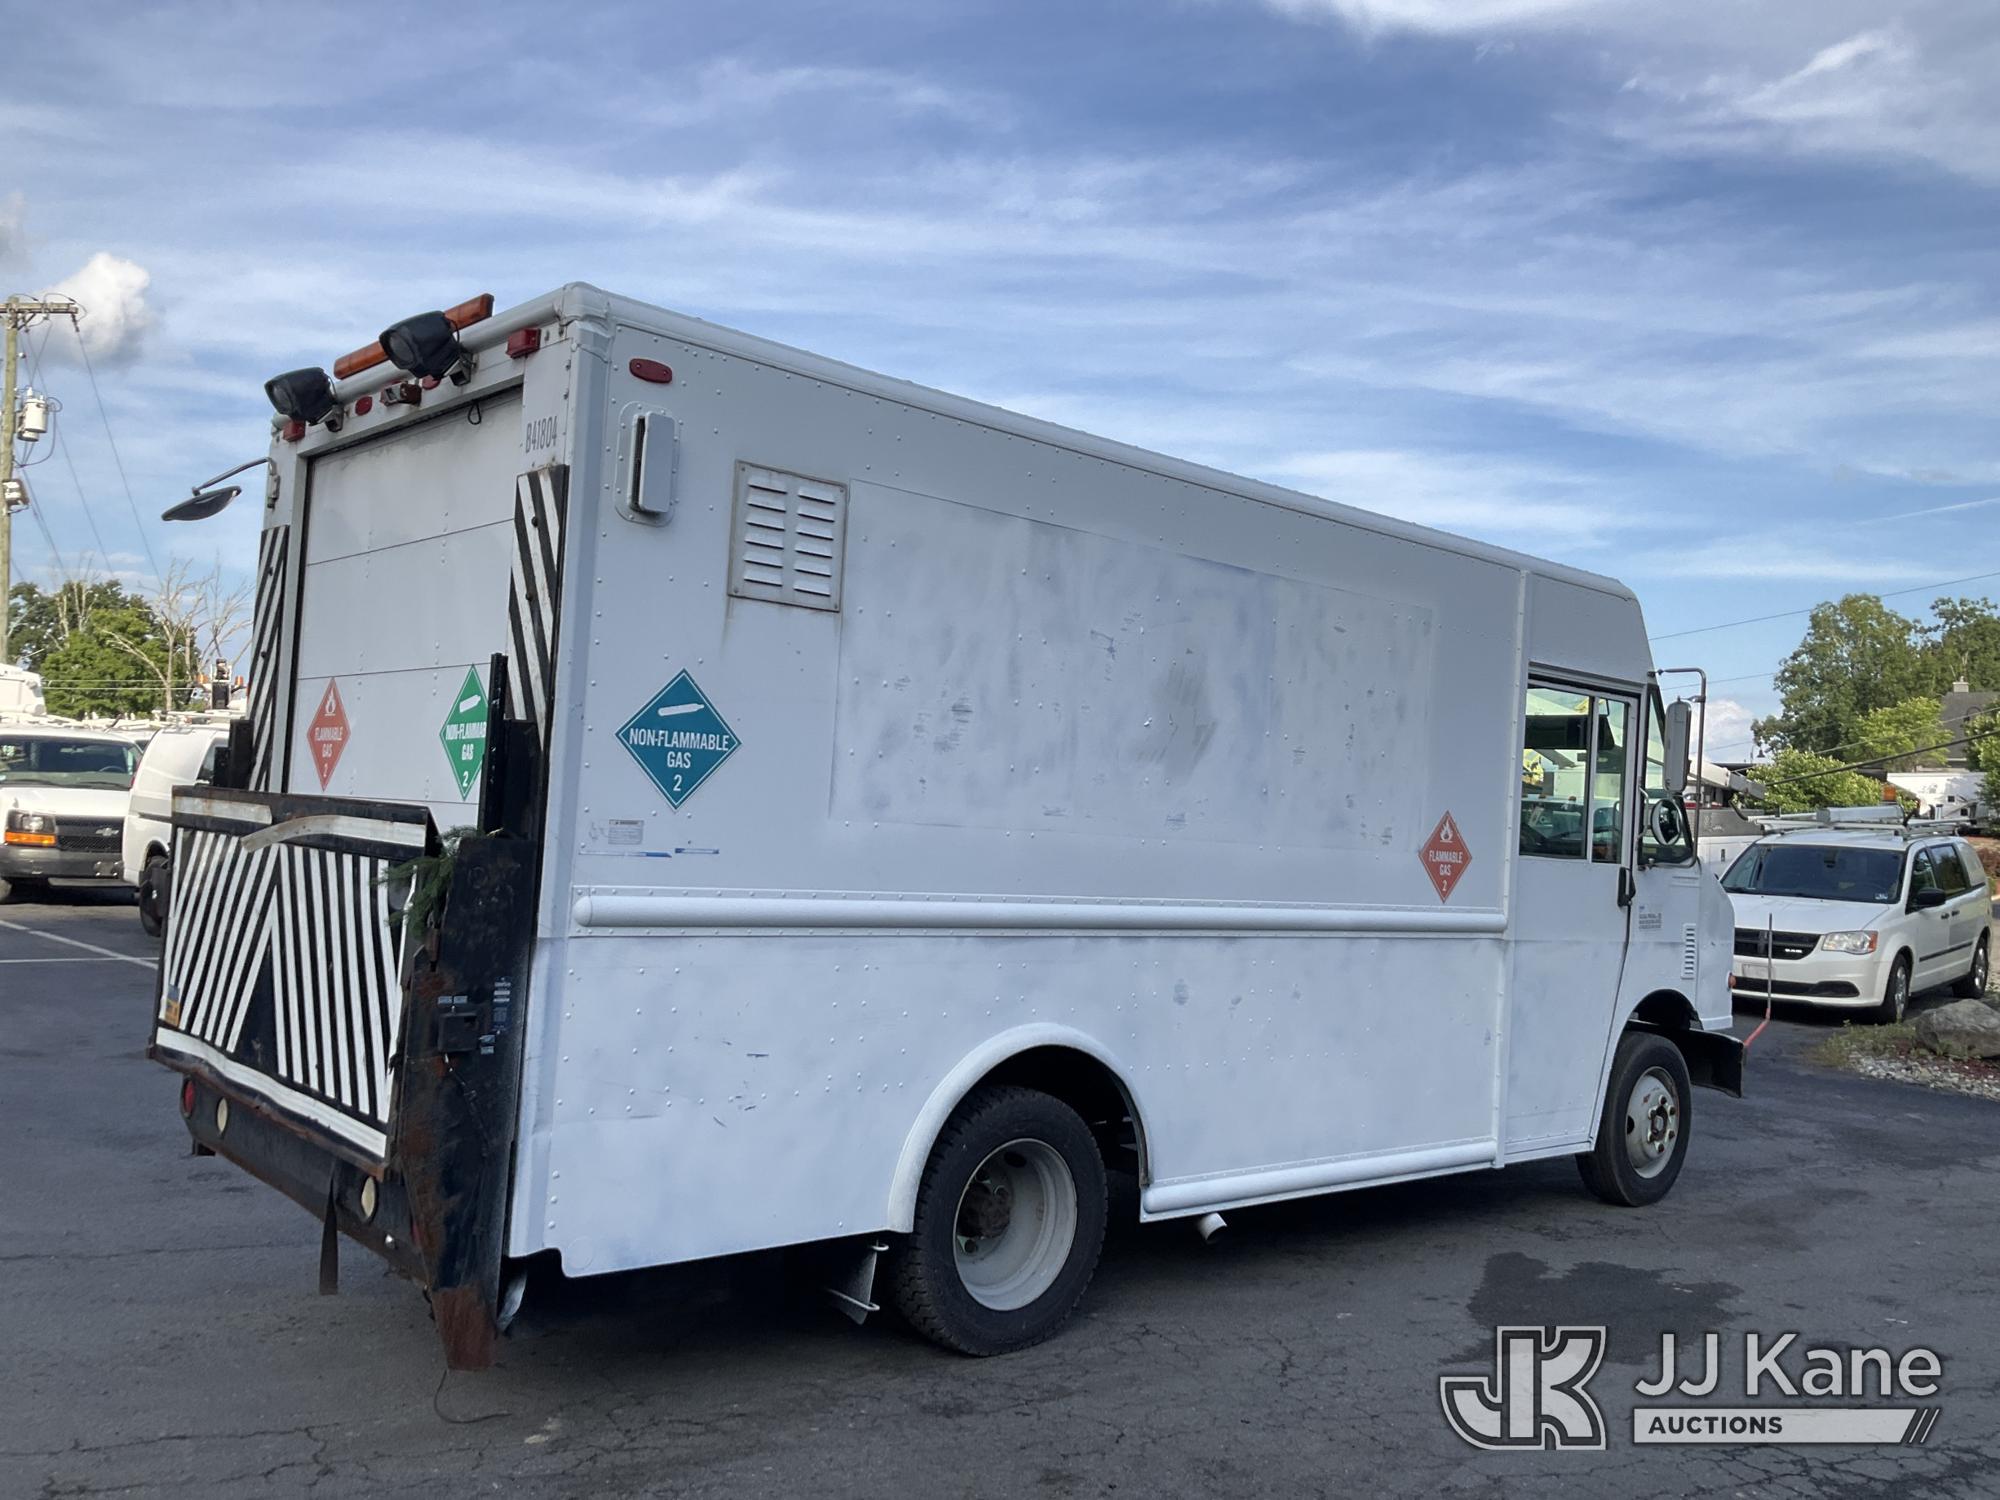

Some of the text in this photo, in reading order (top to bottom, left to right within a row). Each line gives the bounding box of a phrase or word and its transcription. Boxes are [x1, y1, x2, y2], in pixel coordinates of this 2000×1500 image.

[525, 415, 557, 453] B41804
[315, 726, 343, 741] FLAMMABLE
[629, 728, 730, 751] NON-FLAMMABLE
[322, 743, 333, 758] GAS
[461, 743, 474, 760] GAS
[667, 751, 691, 768] GAS
[462, 770, 469, 787] 2
[673, 774, 682, 791] 2
[1429, 850, 1463, 863] FLAMMABLE
[1440, 864, 1451, 876] GAS
[1442, 879, 1448, 891] 2
